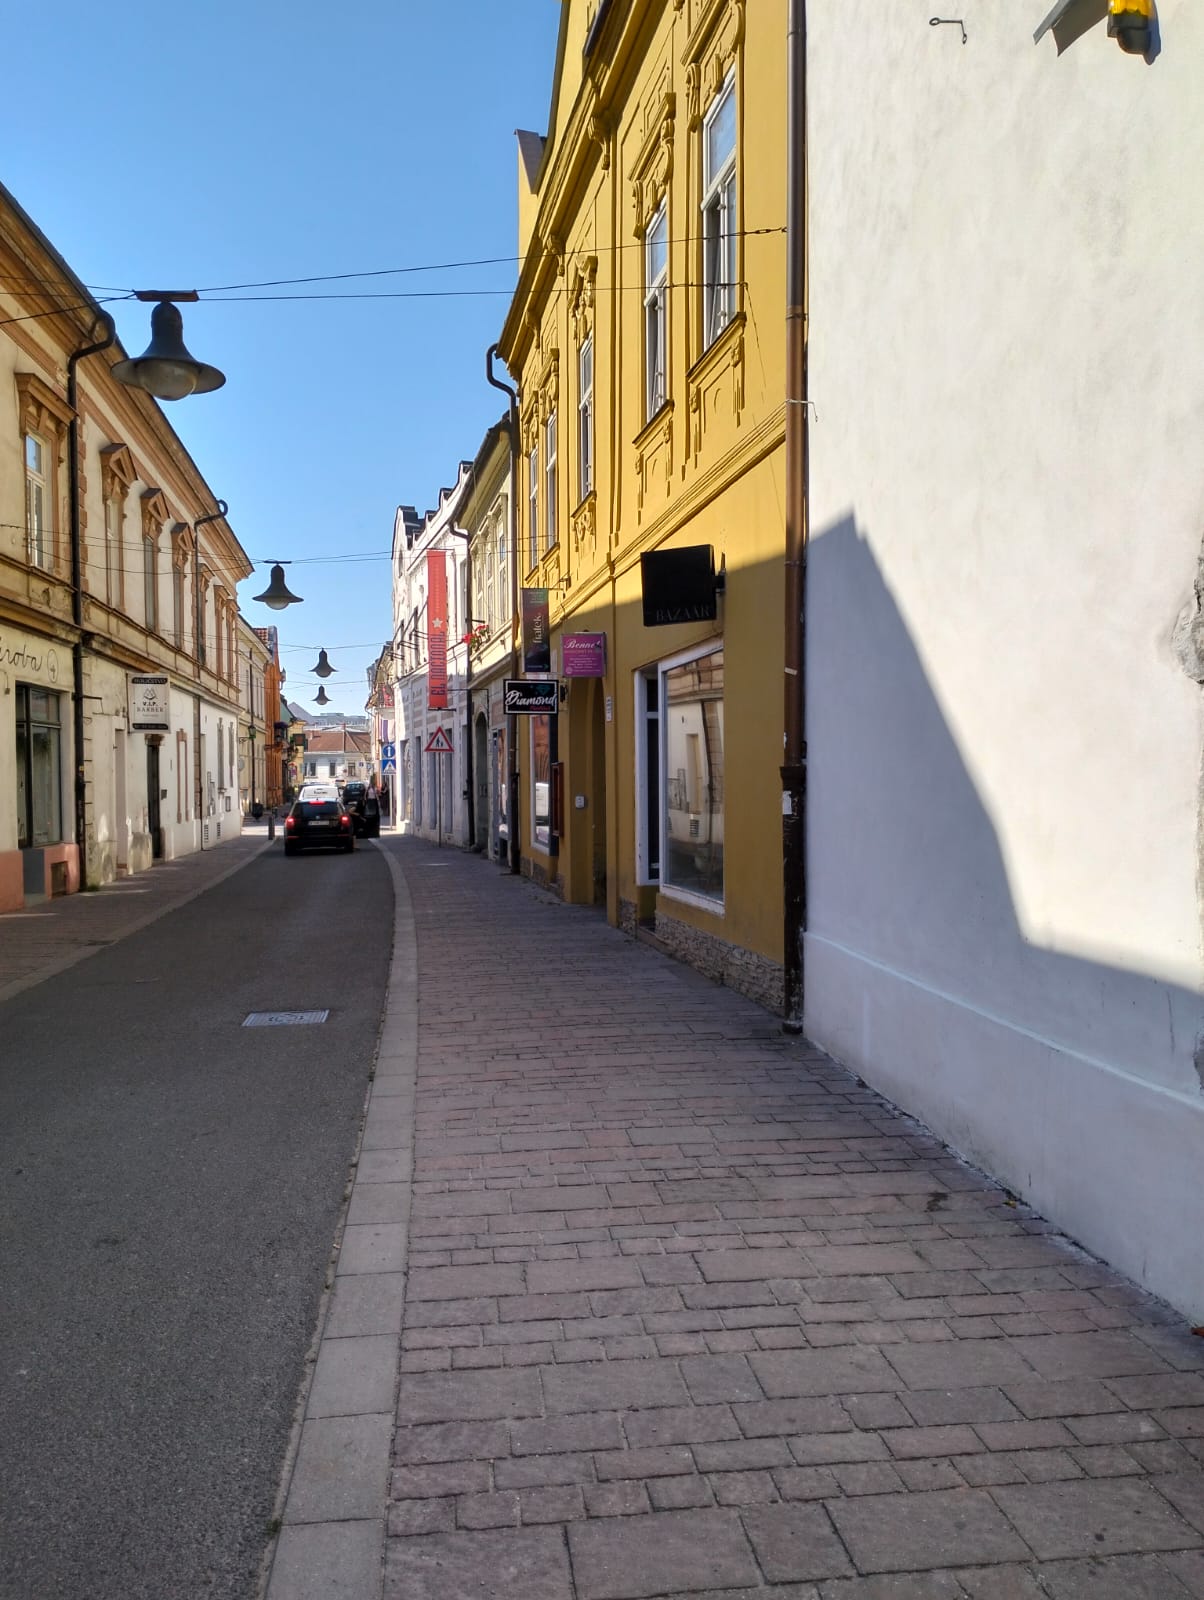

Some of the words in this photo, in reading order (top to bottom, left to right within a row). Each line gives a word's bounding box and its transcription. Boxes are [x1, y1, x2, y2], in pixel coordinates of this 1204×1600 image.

[656, 604, 710, 621] BAZAAR
[430, 683, 445, 695] EL
[505, 690, 557, 706] Diamond
